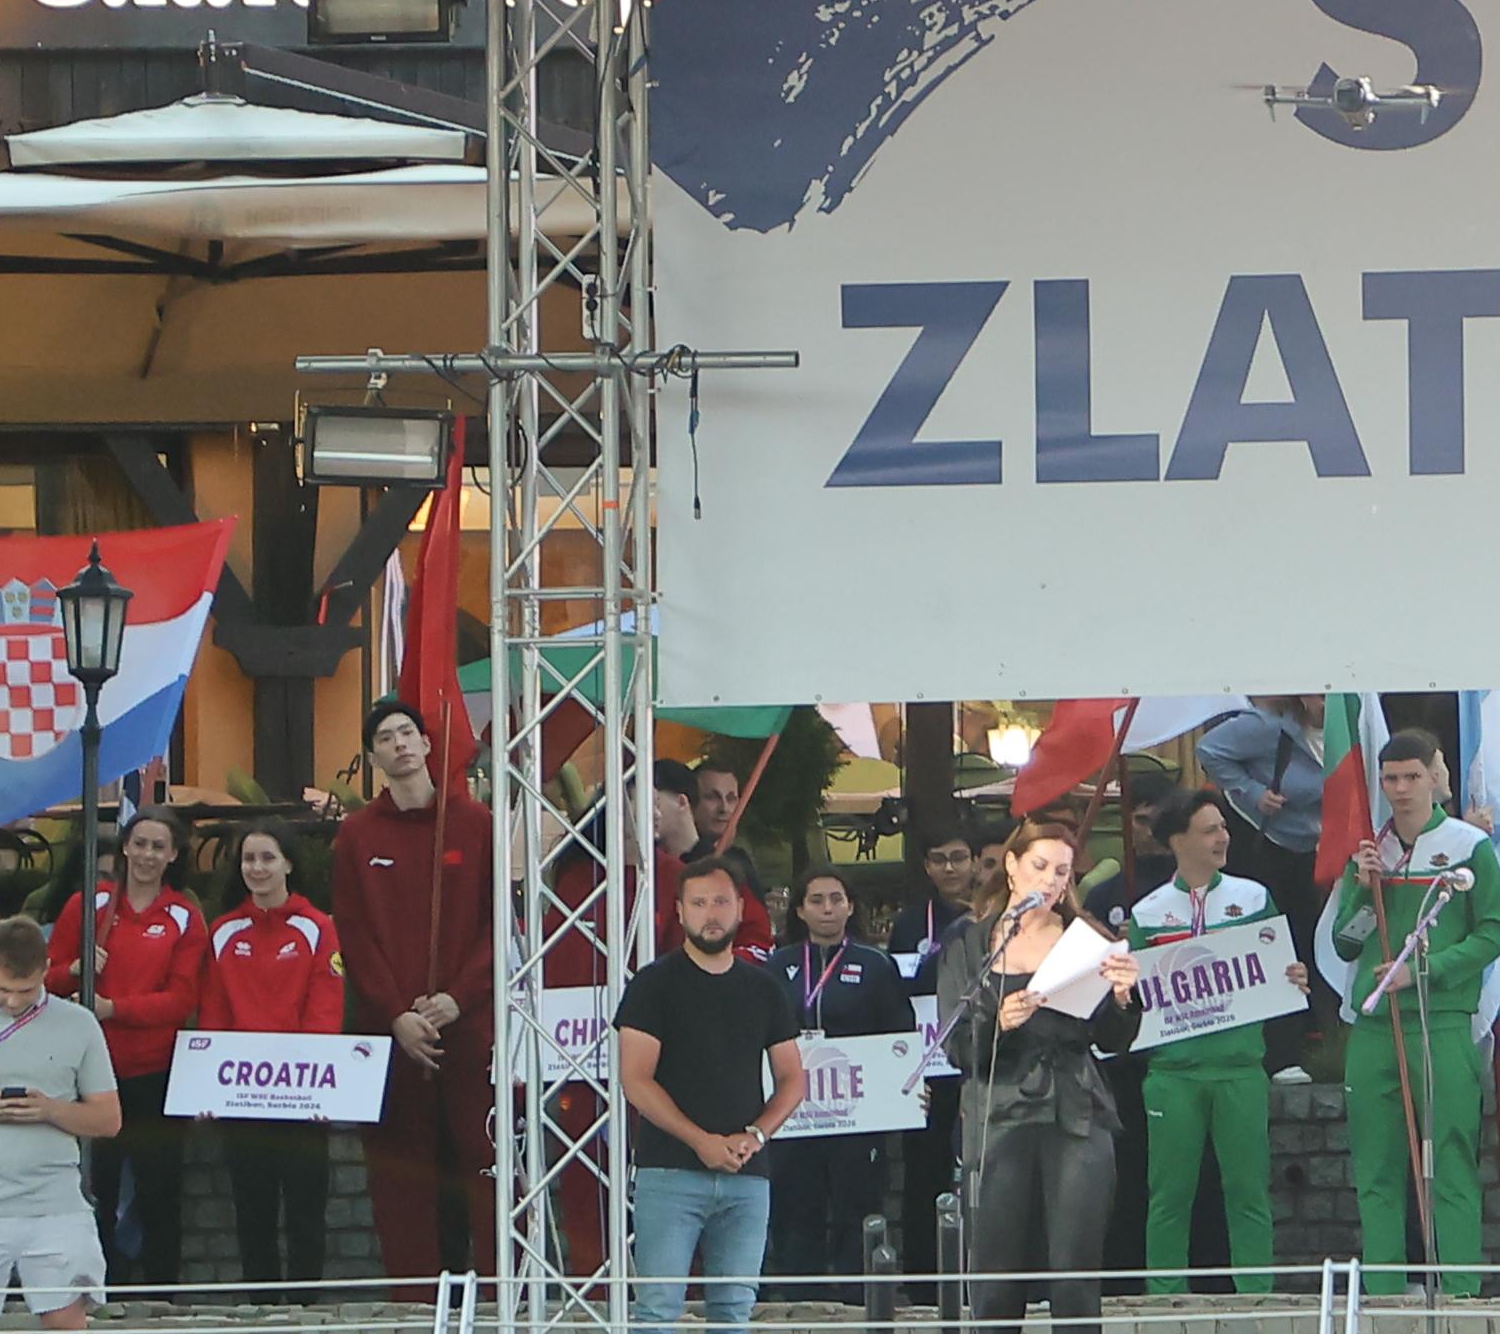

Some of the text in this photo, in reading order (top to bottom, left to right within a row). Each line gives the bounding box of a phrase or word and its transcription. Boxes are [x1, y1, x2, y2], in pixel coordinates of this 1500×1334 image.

[1141, 952, 1267, 1013] ULGARIA
[217, 1060, 336, 1089] CROATIA
[805, 1065, 864, 1102] ILE
